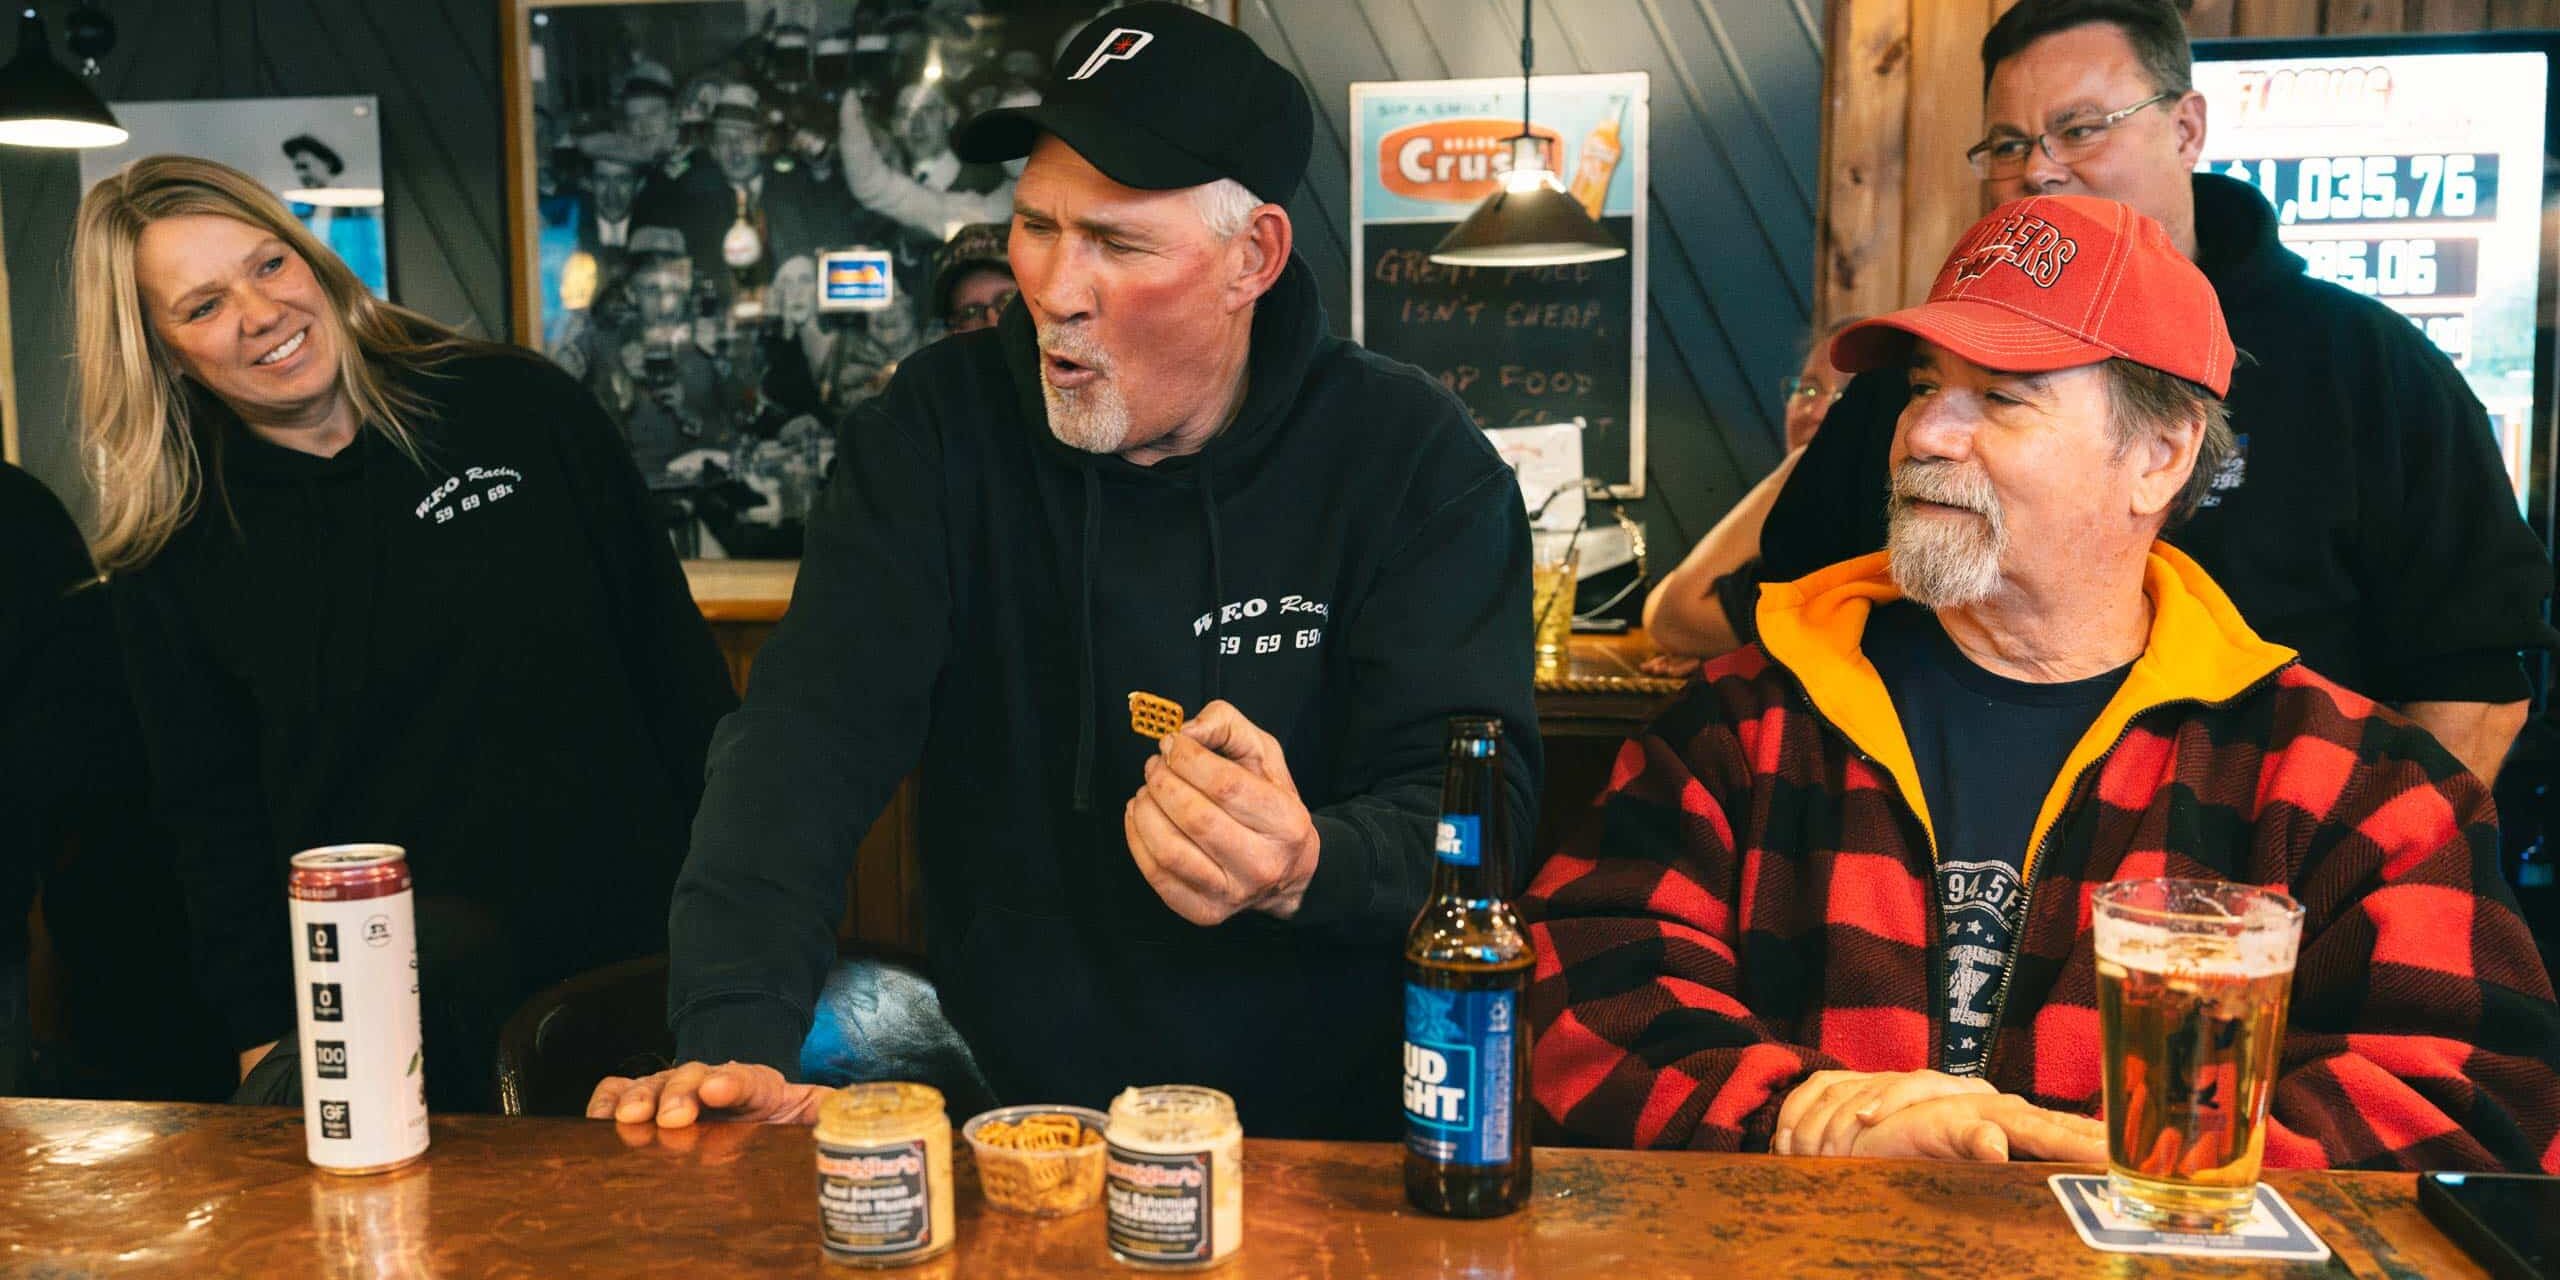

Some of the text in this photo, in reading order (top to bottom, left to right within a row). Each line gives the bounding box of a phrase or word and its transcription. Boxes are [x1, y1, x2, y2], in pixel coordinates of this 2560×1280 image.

[1500, 365, 1593, 395] FOOD
[435, 505, 454, 524] 59
[461, 494, 480, 511] 69
[1255, 634, 1281, 654] 69
[315, 929, 328, 947] 0
[319, 989, 332, 1006] 0
[317, 1047, 345, 1064] 100
[1404, 1041, 1447, 1085] UD
[1404, 1074, 1466, 1123] GHT
[322, 1104, 346, 1121] GF
